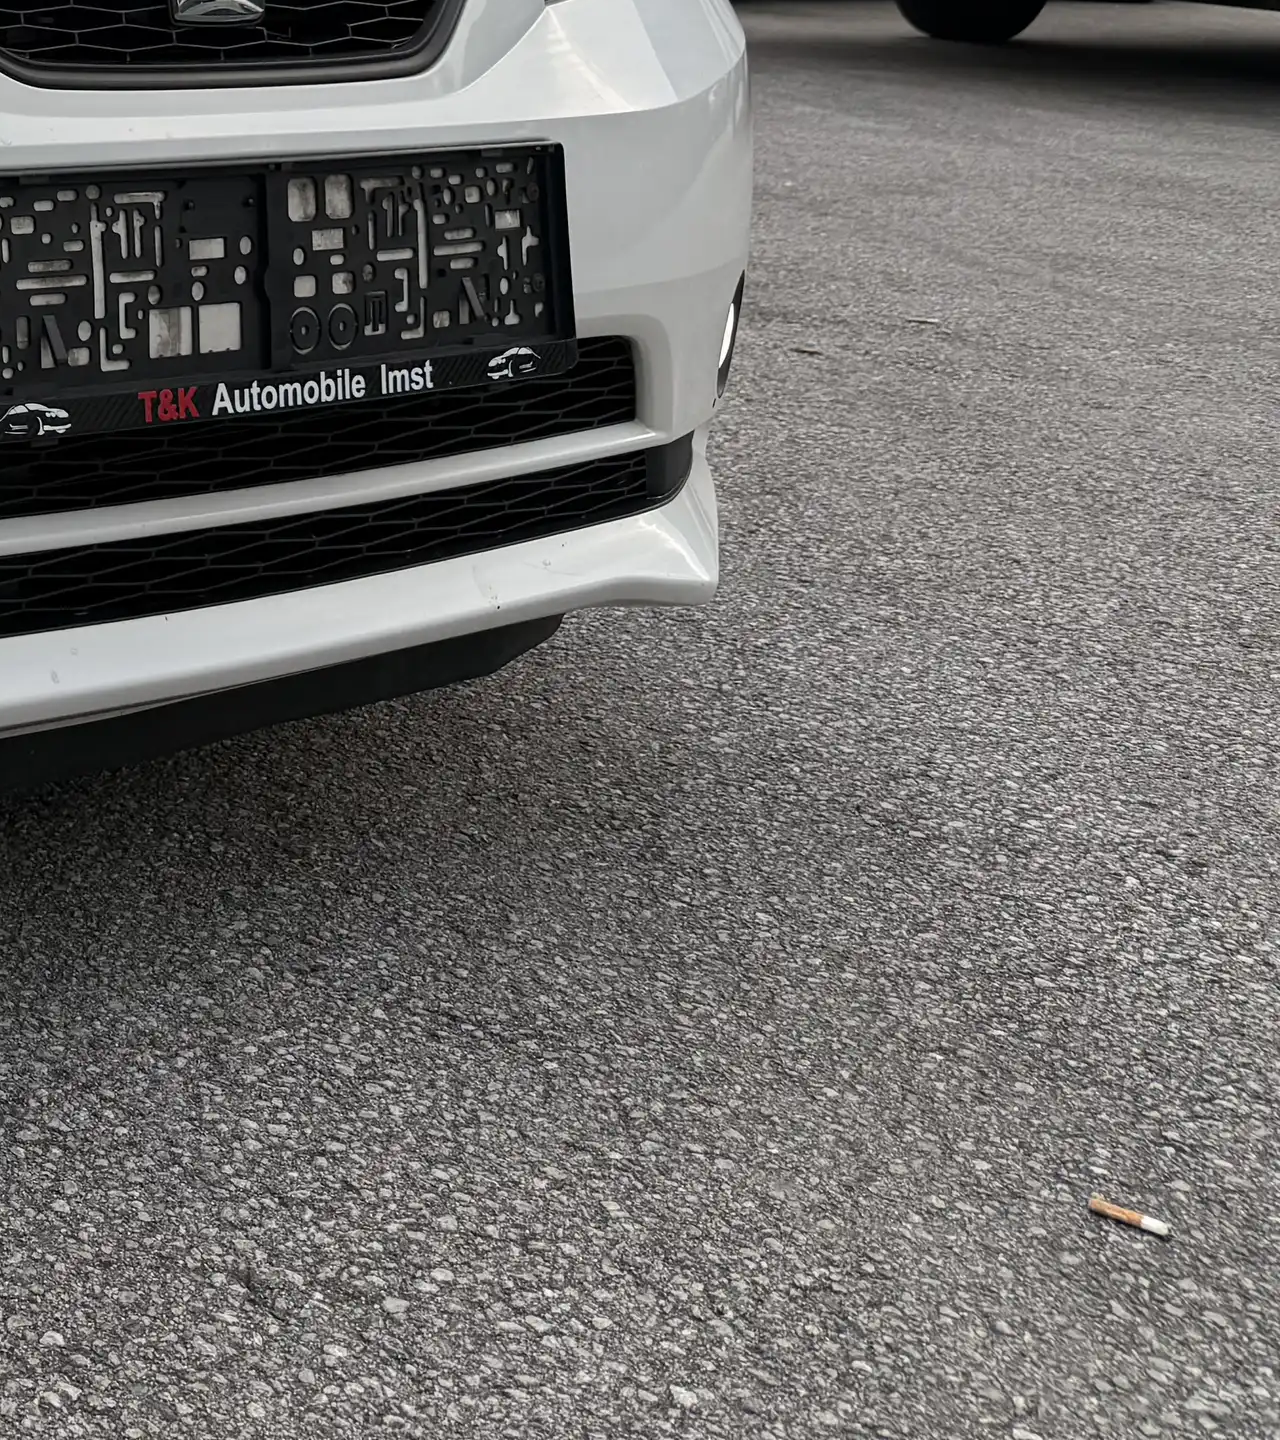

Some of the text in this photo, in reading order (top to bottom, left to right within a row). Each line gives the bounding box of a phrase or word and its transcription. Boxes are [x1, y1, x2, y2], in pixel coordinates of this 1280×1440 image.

[138, 359, 434, 423] T&K Automobile Imst
